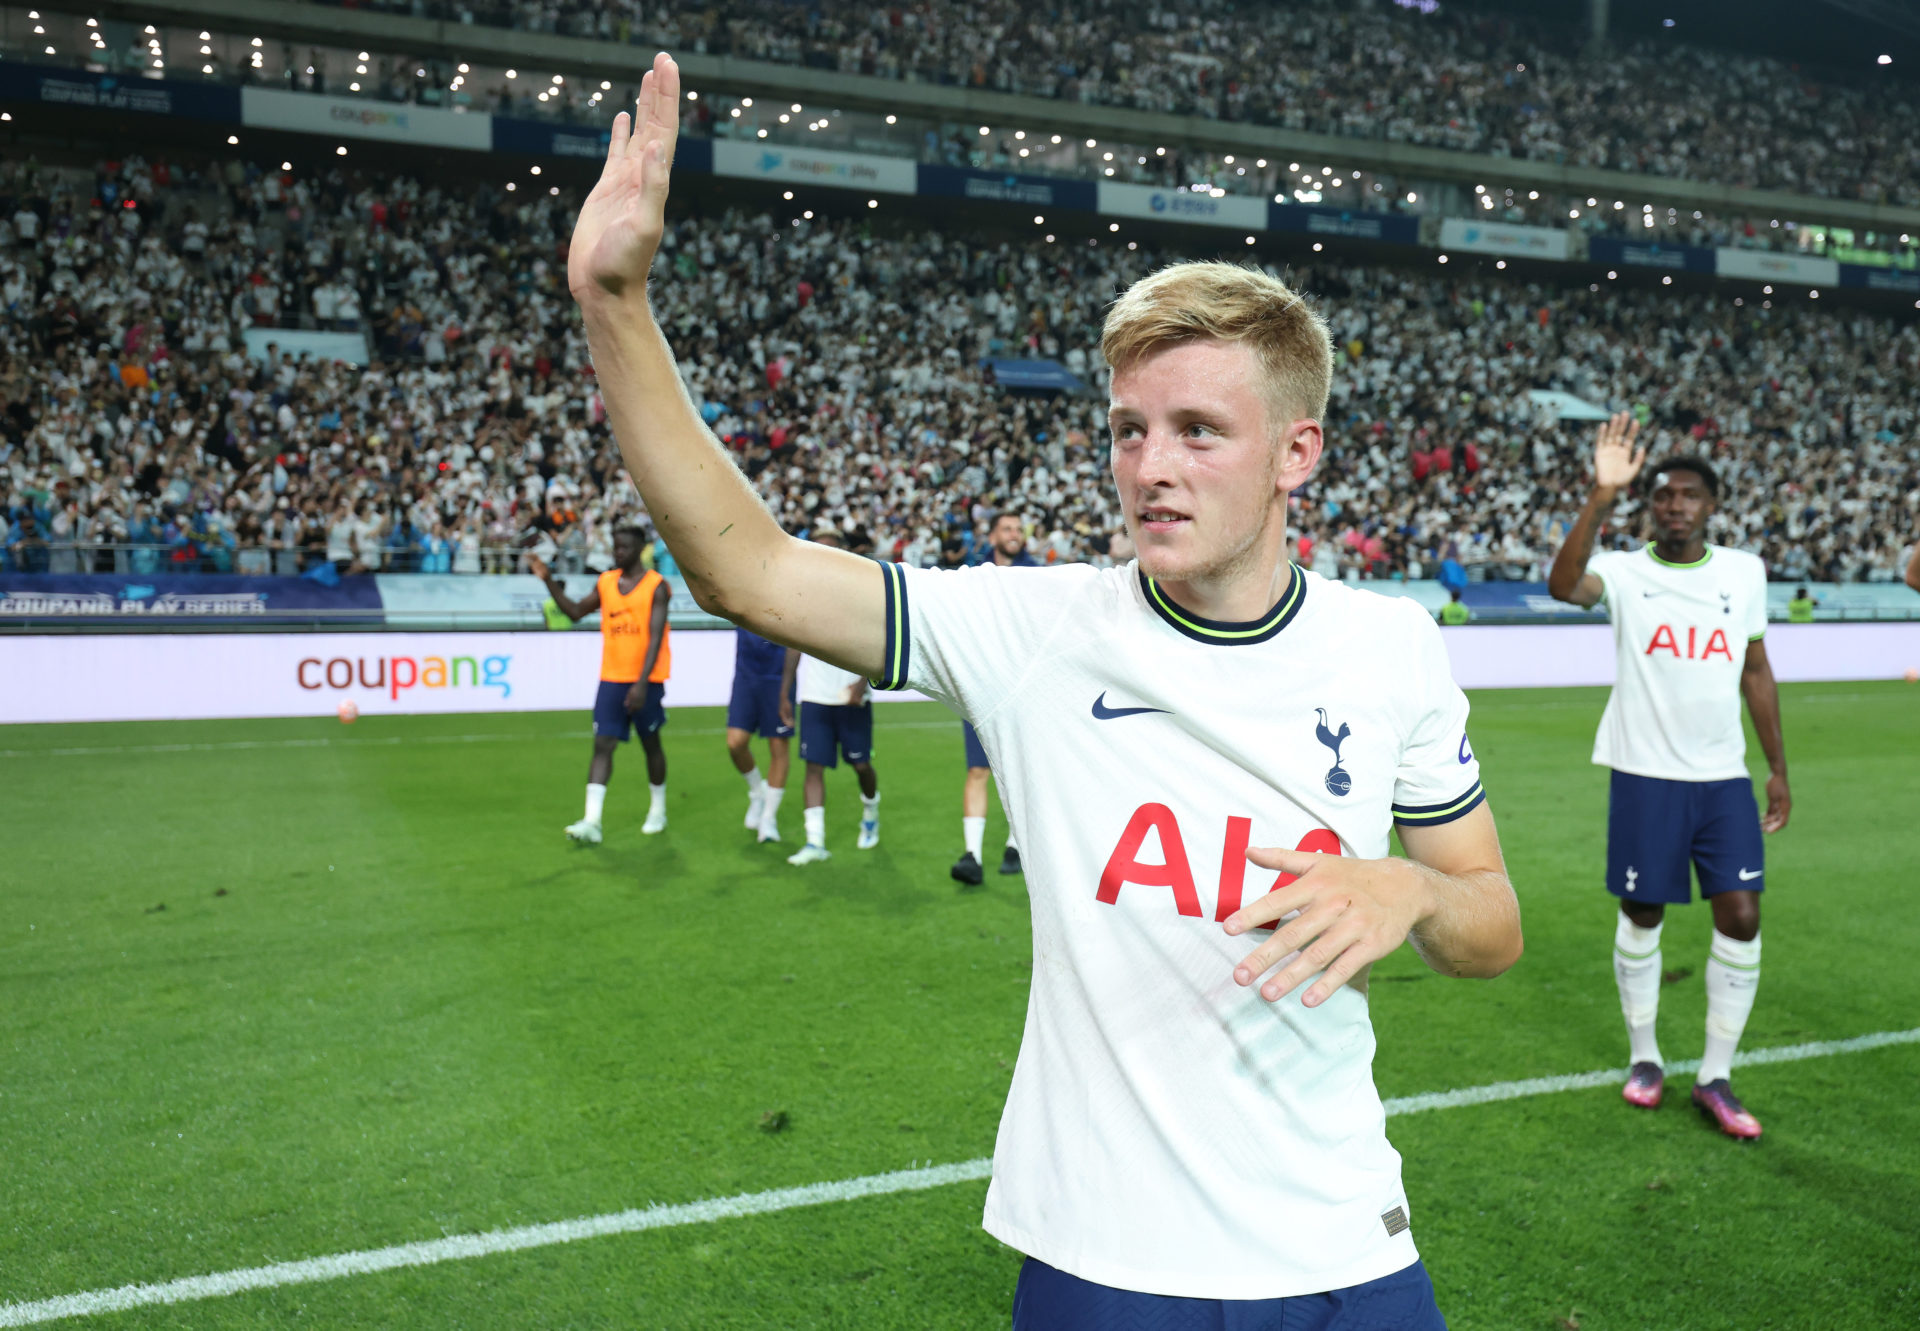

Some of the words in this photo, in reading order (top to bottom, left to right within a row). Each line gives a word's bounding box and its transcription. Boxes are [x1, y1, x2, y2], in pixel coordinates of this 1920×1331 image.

[0, 599, 114, 615] COUPANG
[121, 599, 179, 615] PLAY
[184, 599, 266, 615] SERIES
[1645, 624, 1733, 662] AIA
[297, 655, 512, 701] coupang
